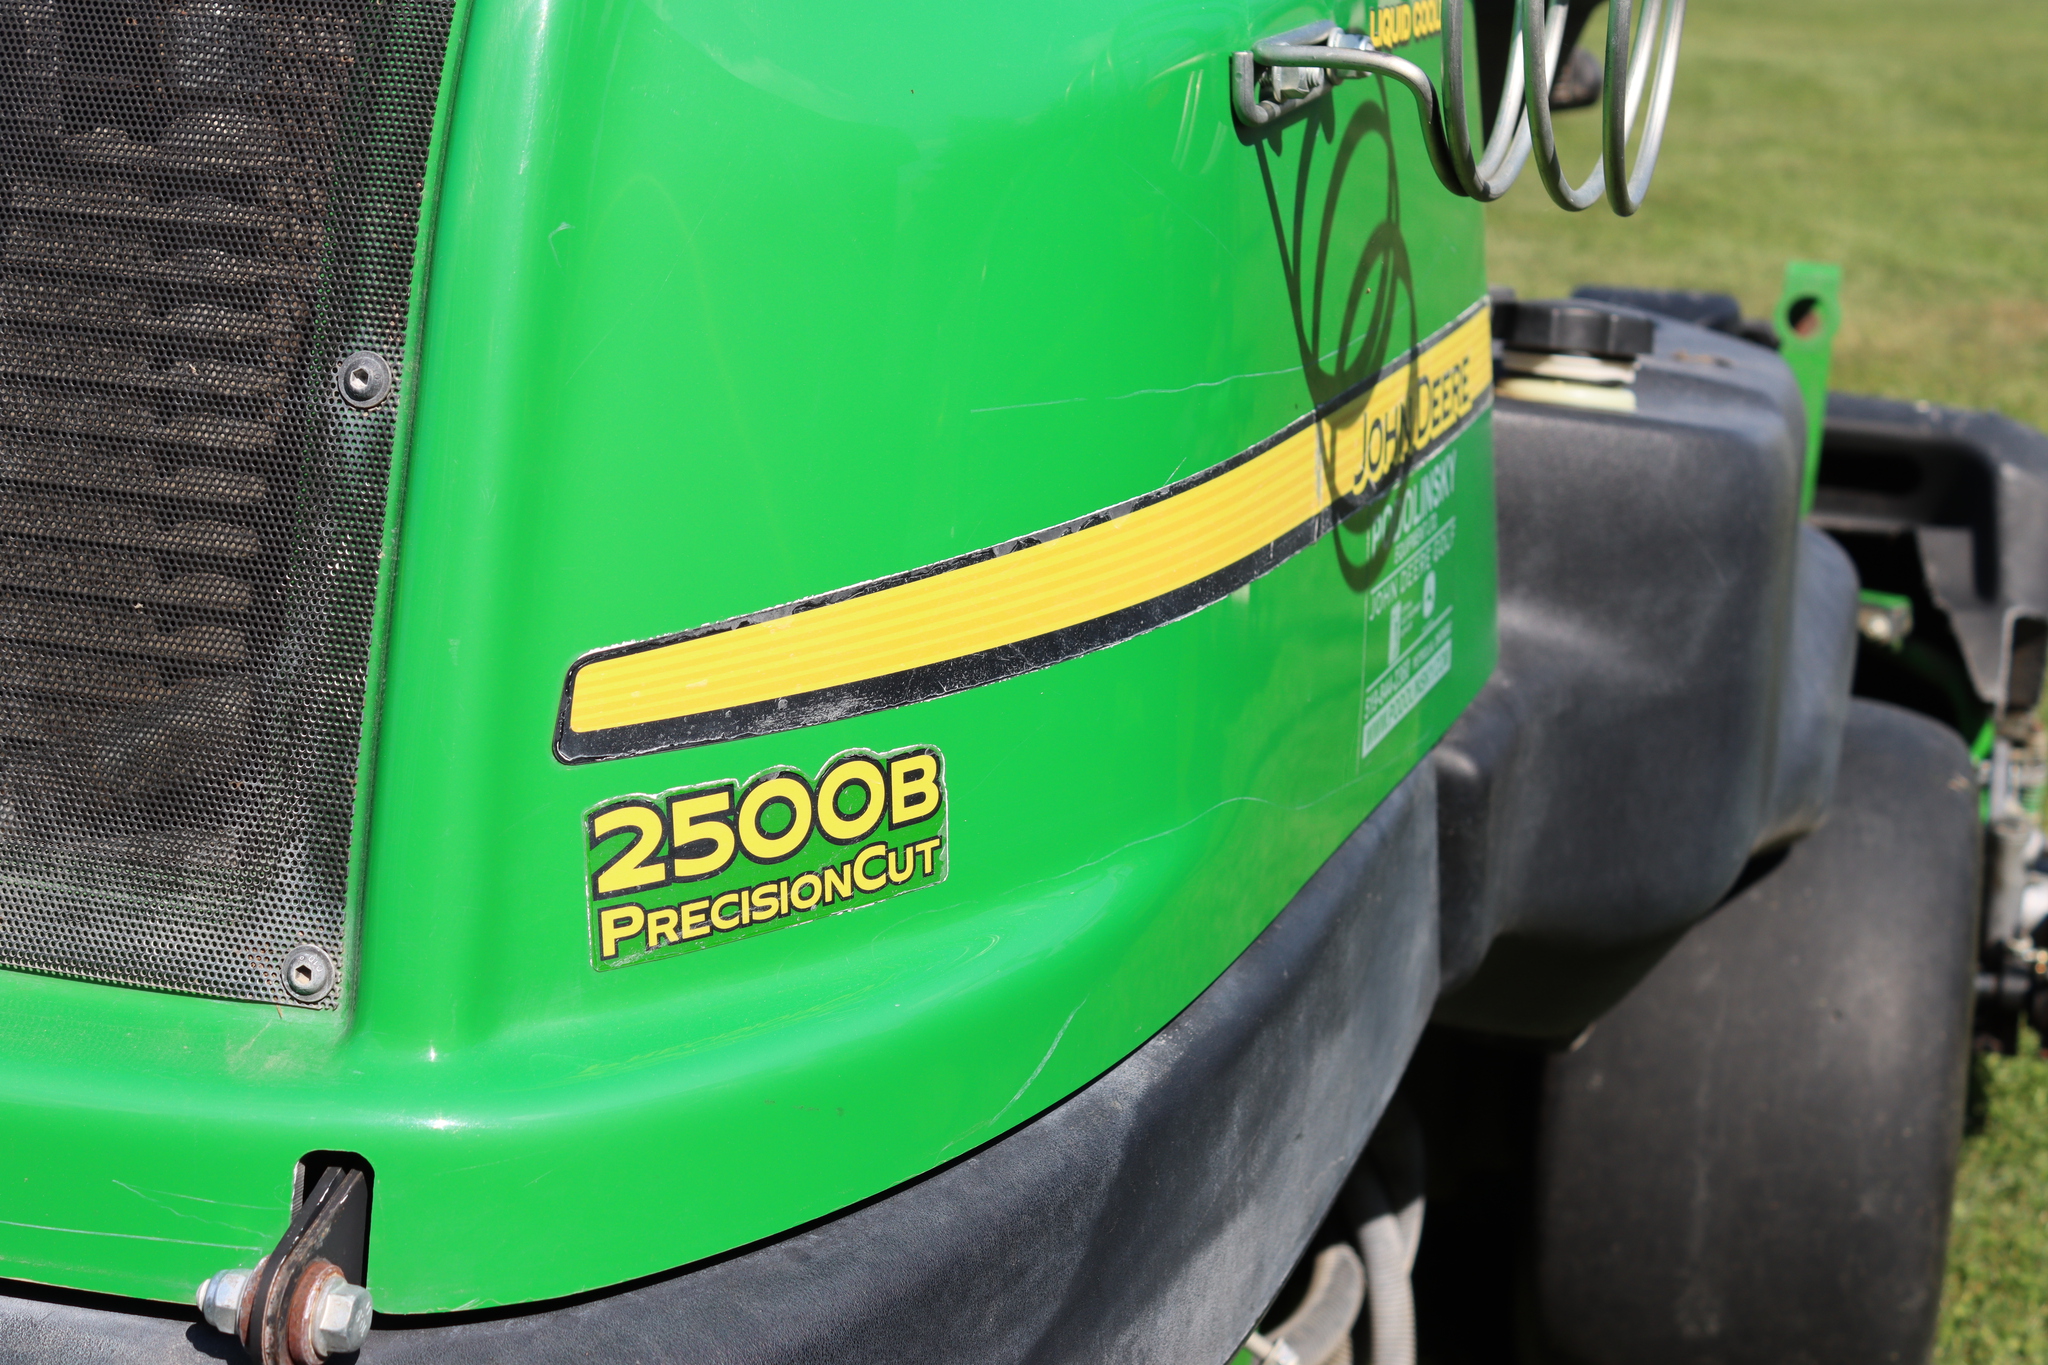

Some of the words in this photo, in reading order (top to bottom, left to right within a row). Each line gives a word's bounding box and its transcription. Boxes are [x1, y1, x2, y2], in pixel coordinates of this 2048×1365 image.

[1370, 4, 1411, 50] LIQUID
[1354, 397, 1414, 486] JOHN
[1417, 357, 1470, 442] DEERE
[591, 752, 943, 898] 2500B
